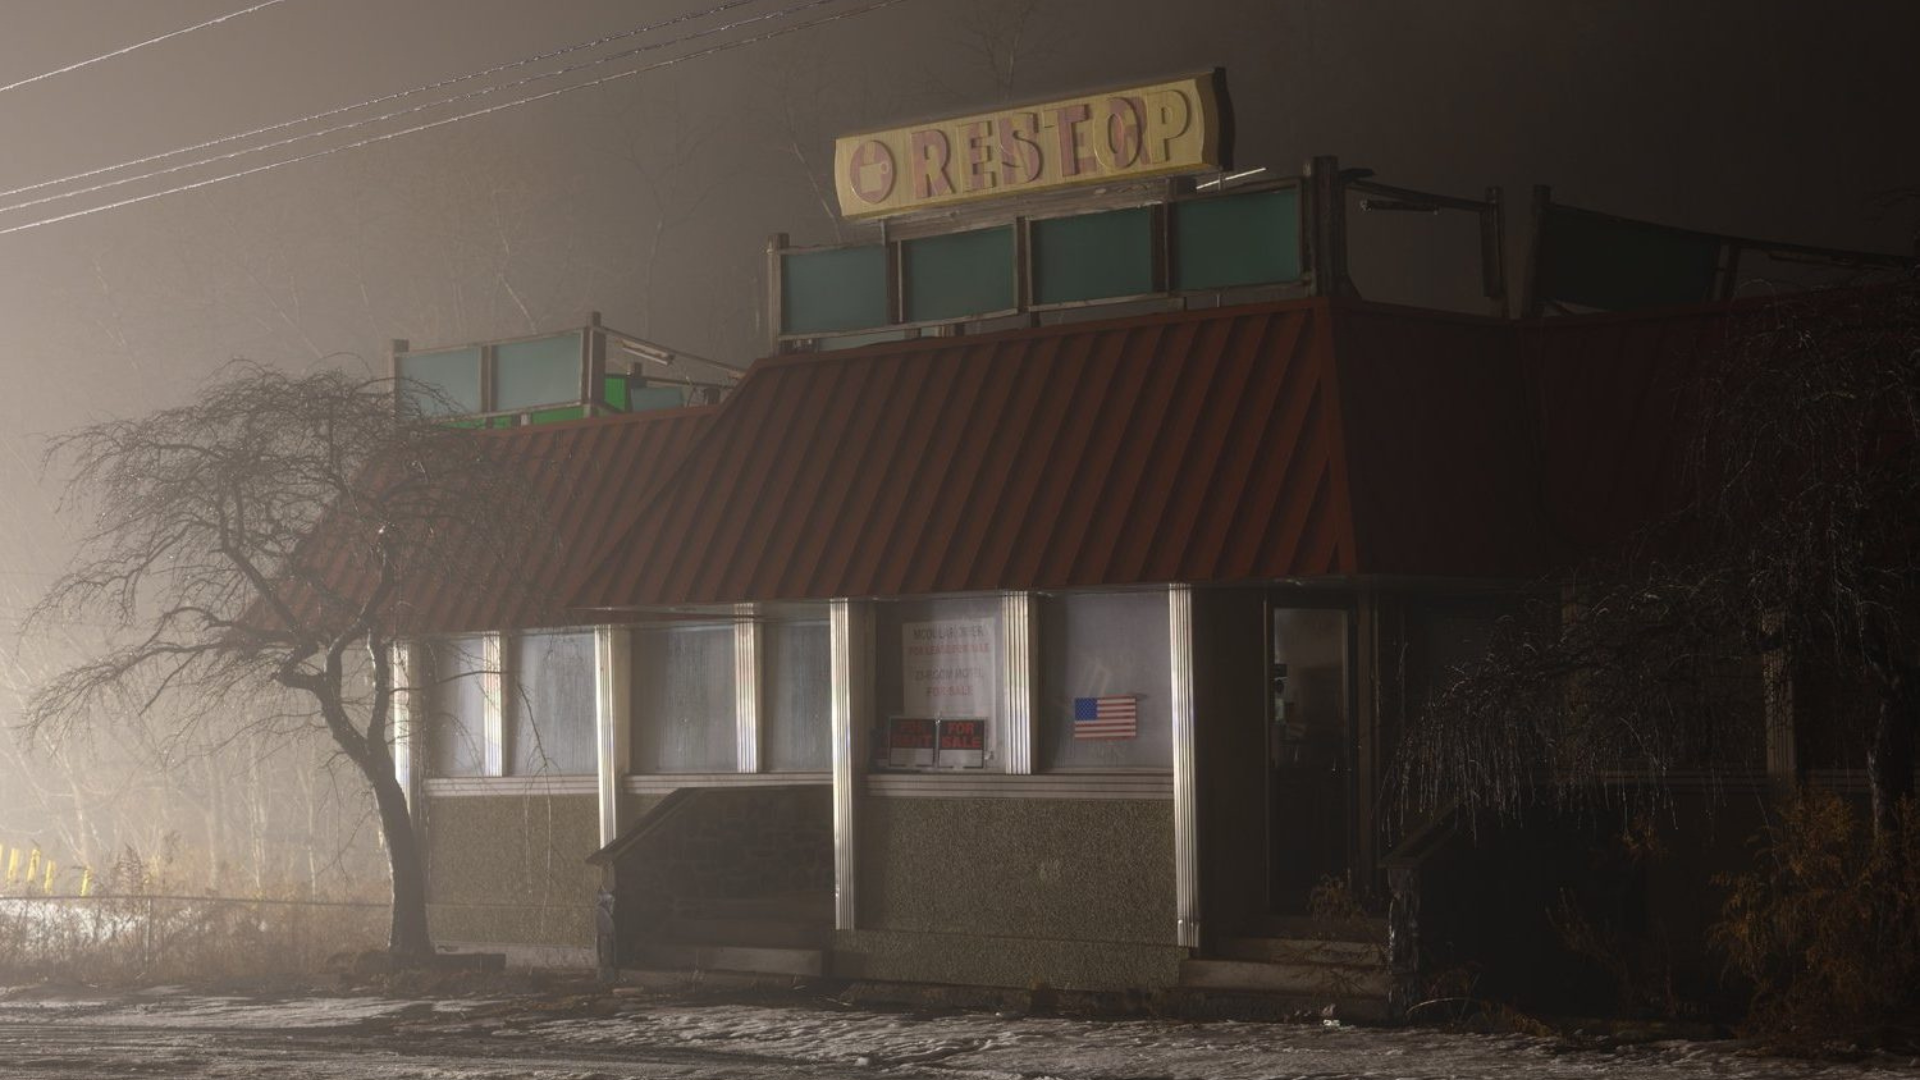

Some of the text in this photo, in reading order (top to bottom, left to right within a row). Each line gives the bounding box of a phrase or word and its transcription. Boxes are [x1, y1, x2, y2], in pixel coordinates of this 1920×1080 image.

[910, 89, 1190, 198] RESTOP
[946, 722, 976, 735] FOR
[941, 736, 982, 749] SALE
